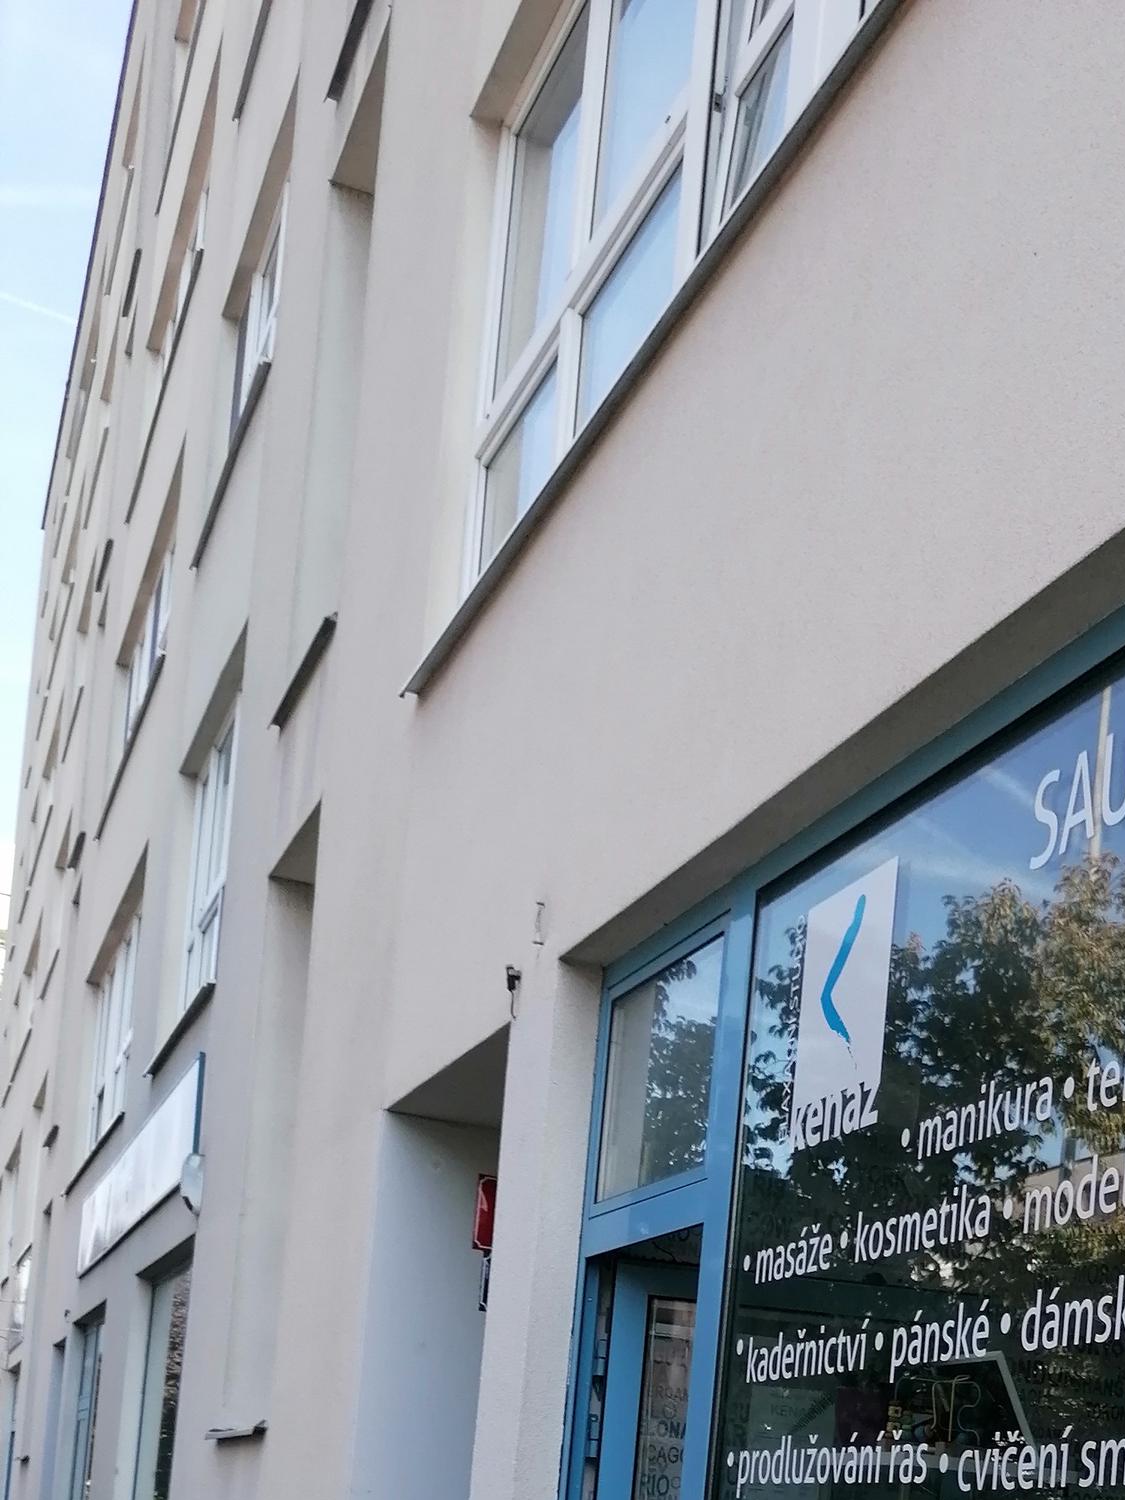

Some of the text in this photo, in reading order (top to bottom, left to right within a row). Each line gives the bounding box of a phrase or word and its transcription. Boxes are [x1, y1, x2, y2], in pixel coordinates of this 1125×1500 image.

[791, 1081, 878, 1153] kenaz
[918, 1076, 1053, 1160] manikura
[755, 1223, 833, 1284] masáže
[854, 1184, 991, 1263] kosmetika
[746, 1318, 870, 1383] kadeřnictví
[889, 1299, 990, 1384] pánské
[736, 1430, 885, 1498] prodlužování
[888, 1429, 929, 1484] řas
[957, 1425, 1073, 1492] cvičení
